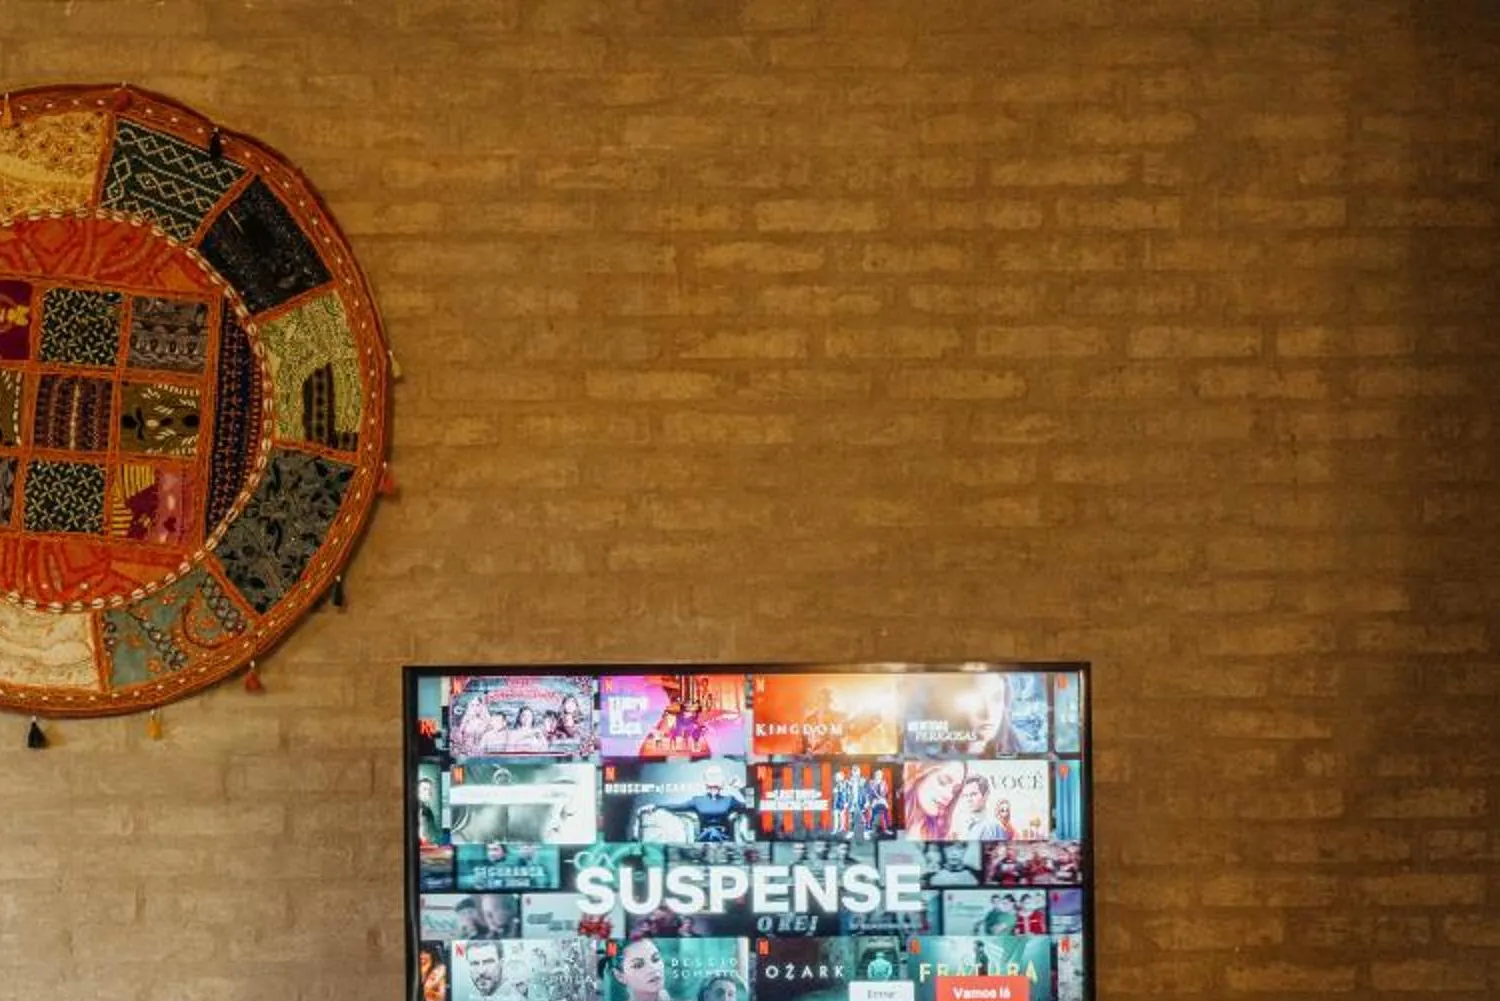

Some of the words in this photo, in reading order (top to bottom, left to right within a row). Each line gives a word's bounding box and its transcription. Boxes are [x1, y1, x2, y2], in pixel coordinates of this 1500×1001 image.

[755, 723, 843, 736] KINGDOM
[989, 771, 1043, 789] VOCÊ
[575, 863, 924, 915] SUSPENSE
[952, 987, 997, 1000] Vamos
